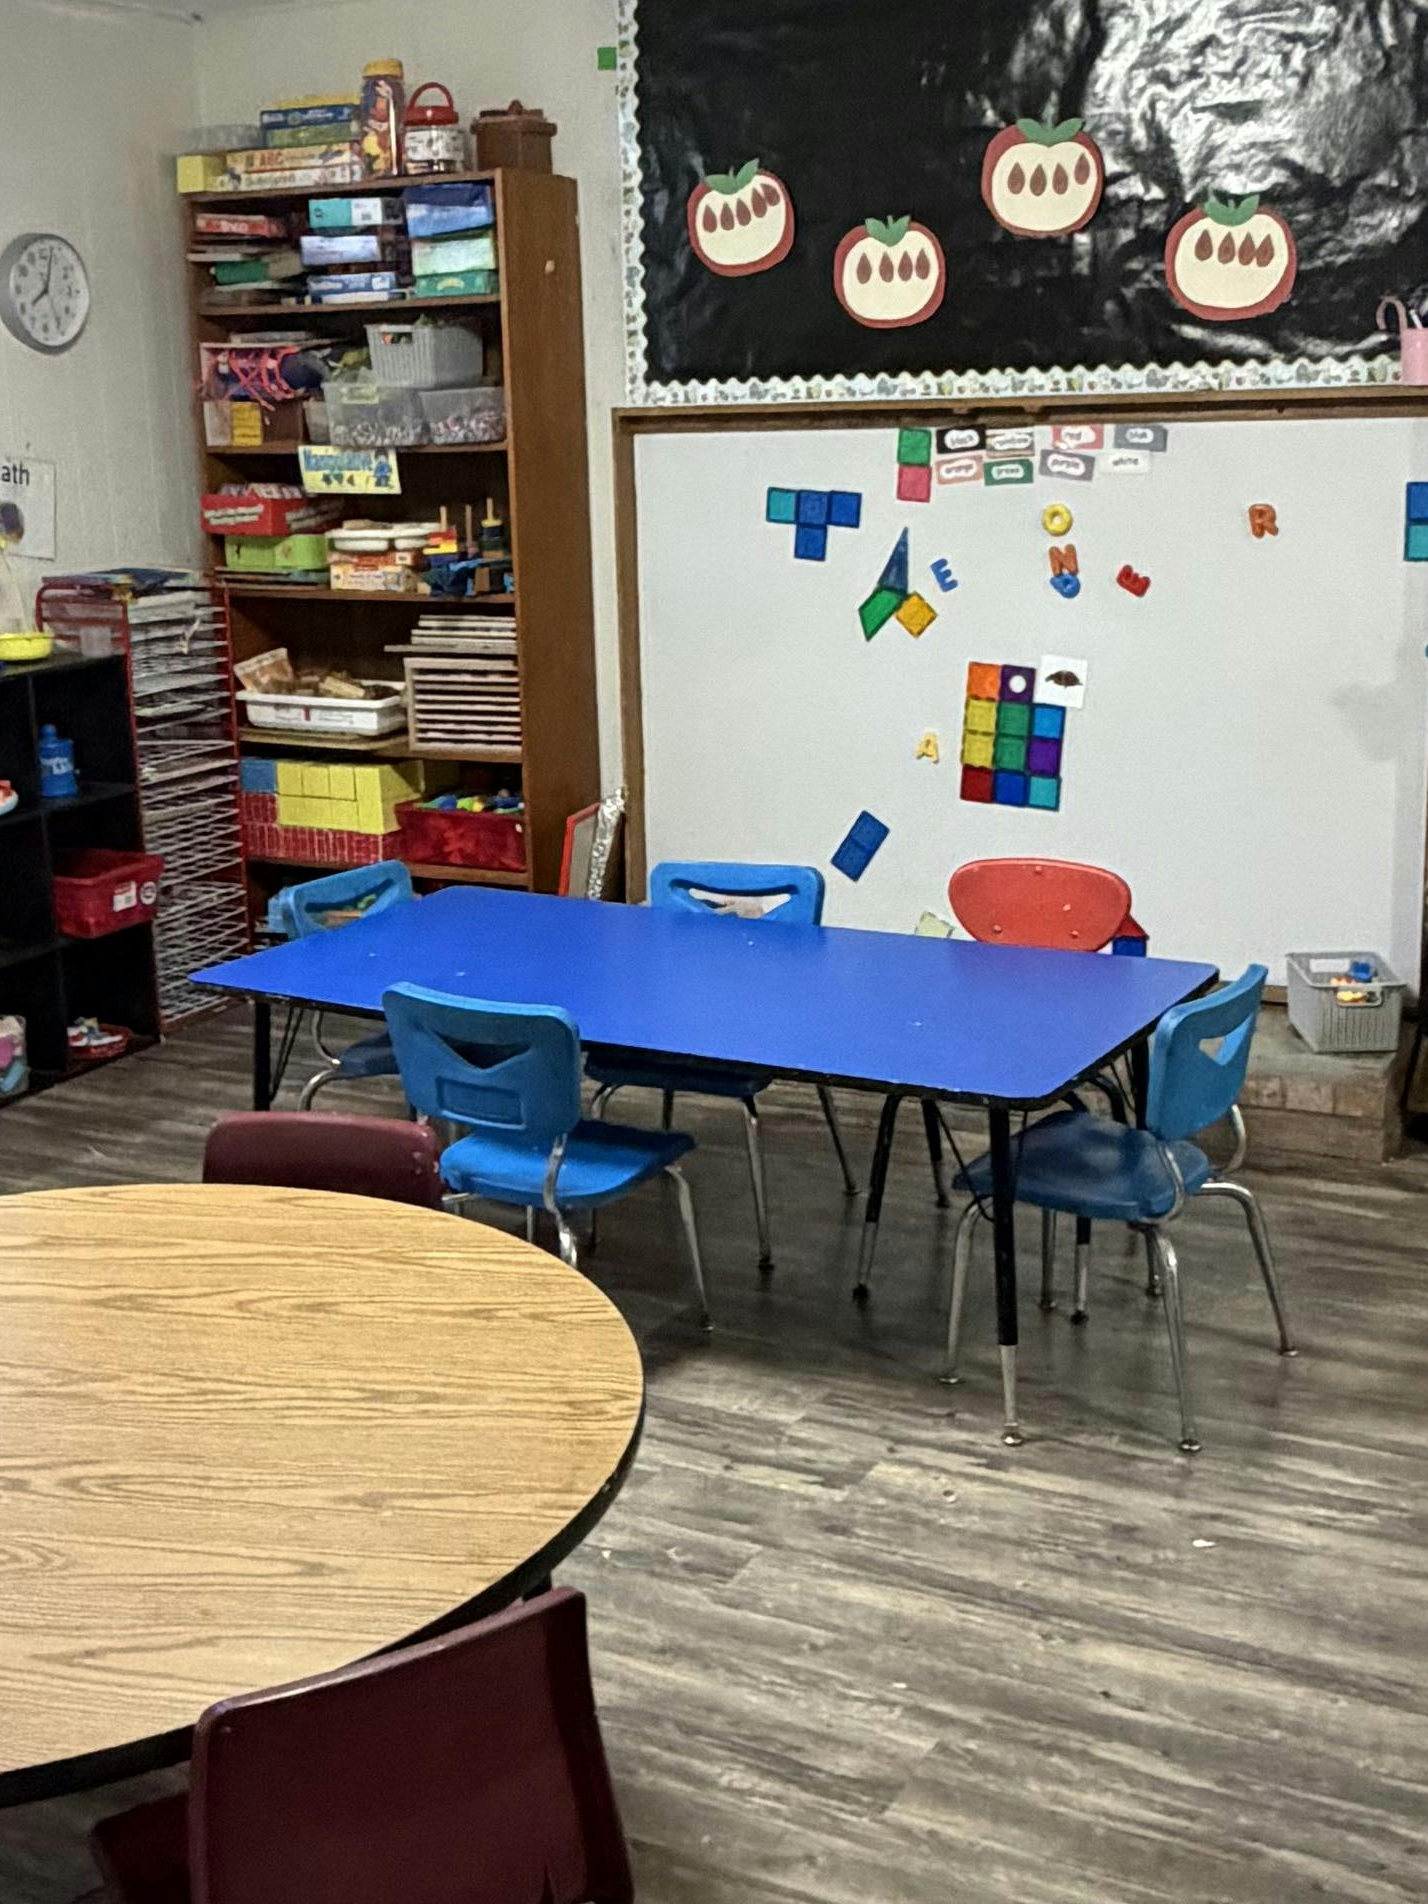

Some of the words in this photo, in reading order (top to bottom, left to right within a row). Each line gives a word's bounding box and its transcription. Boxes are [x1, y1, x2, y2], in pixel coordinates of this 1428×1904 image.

[1248, 503, 1279, 539] R
[930, 558, 959, 593] E
[916, 732, 940, 763] A
